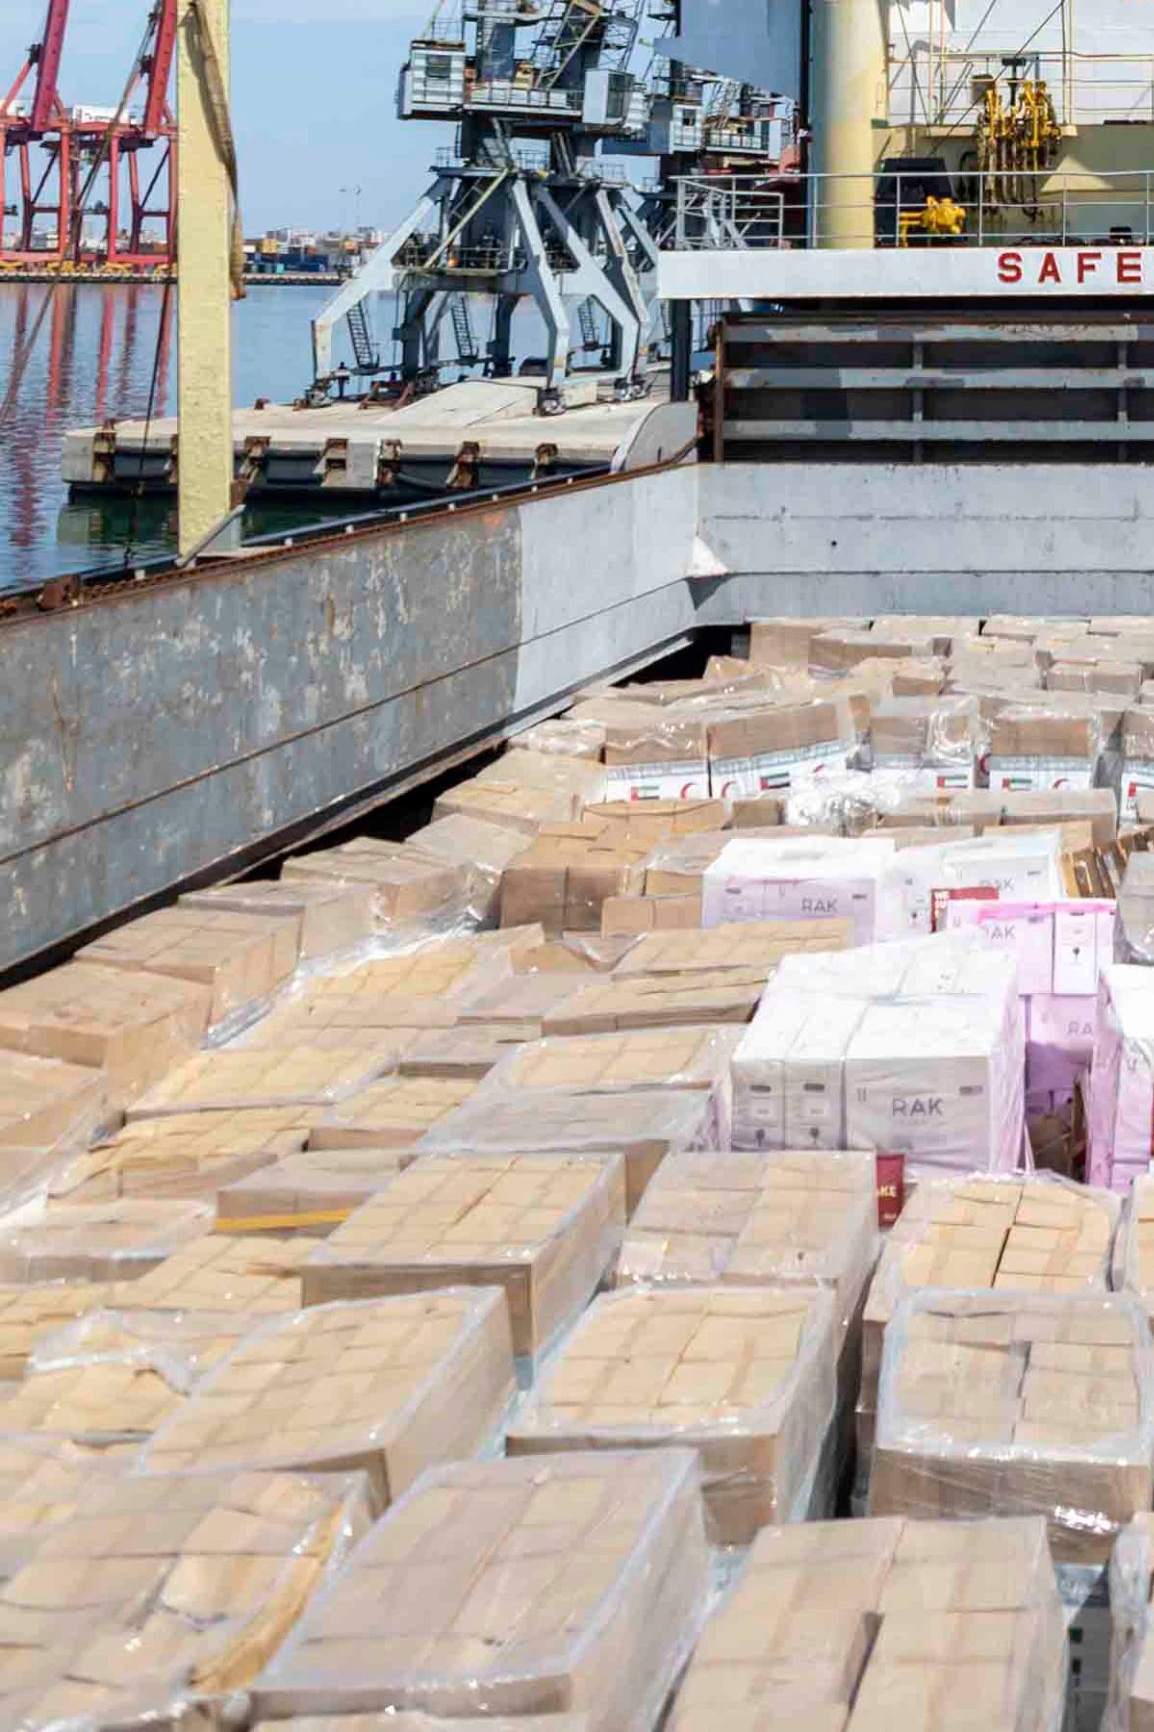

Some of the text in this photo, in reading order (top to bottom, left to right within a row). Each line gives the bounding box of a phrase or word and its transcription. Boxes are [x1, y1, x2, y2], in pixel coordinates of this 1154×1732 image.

[801, 897, 838, 913] RAK
[1068, 1021, 1093, 1035] RA
[893, 1097, 944, 1117] RAK
